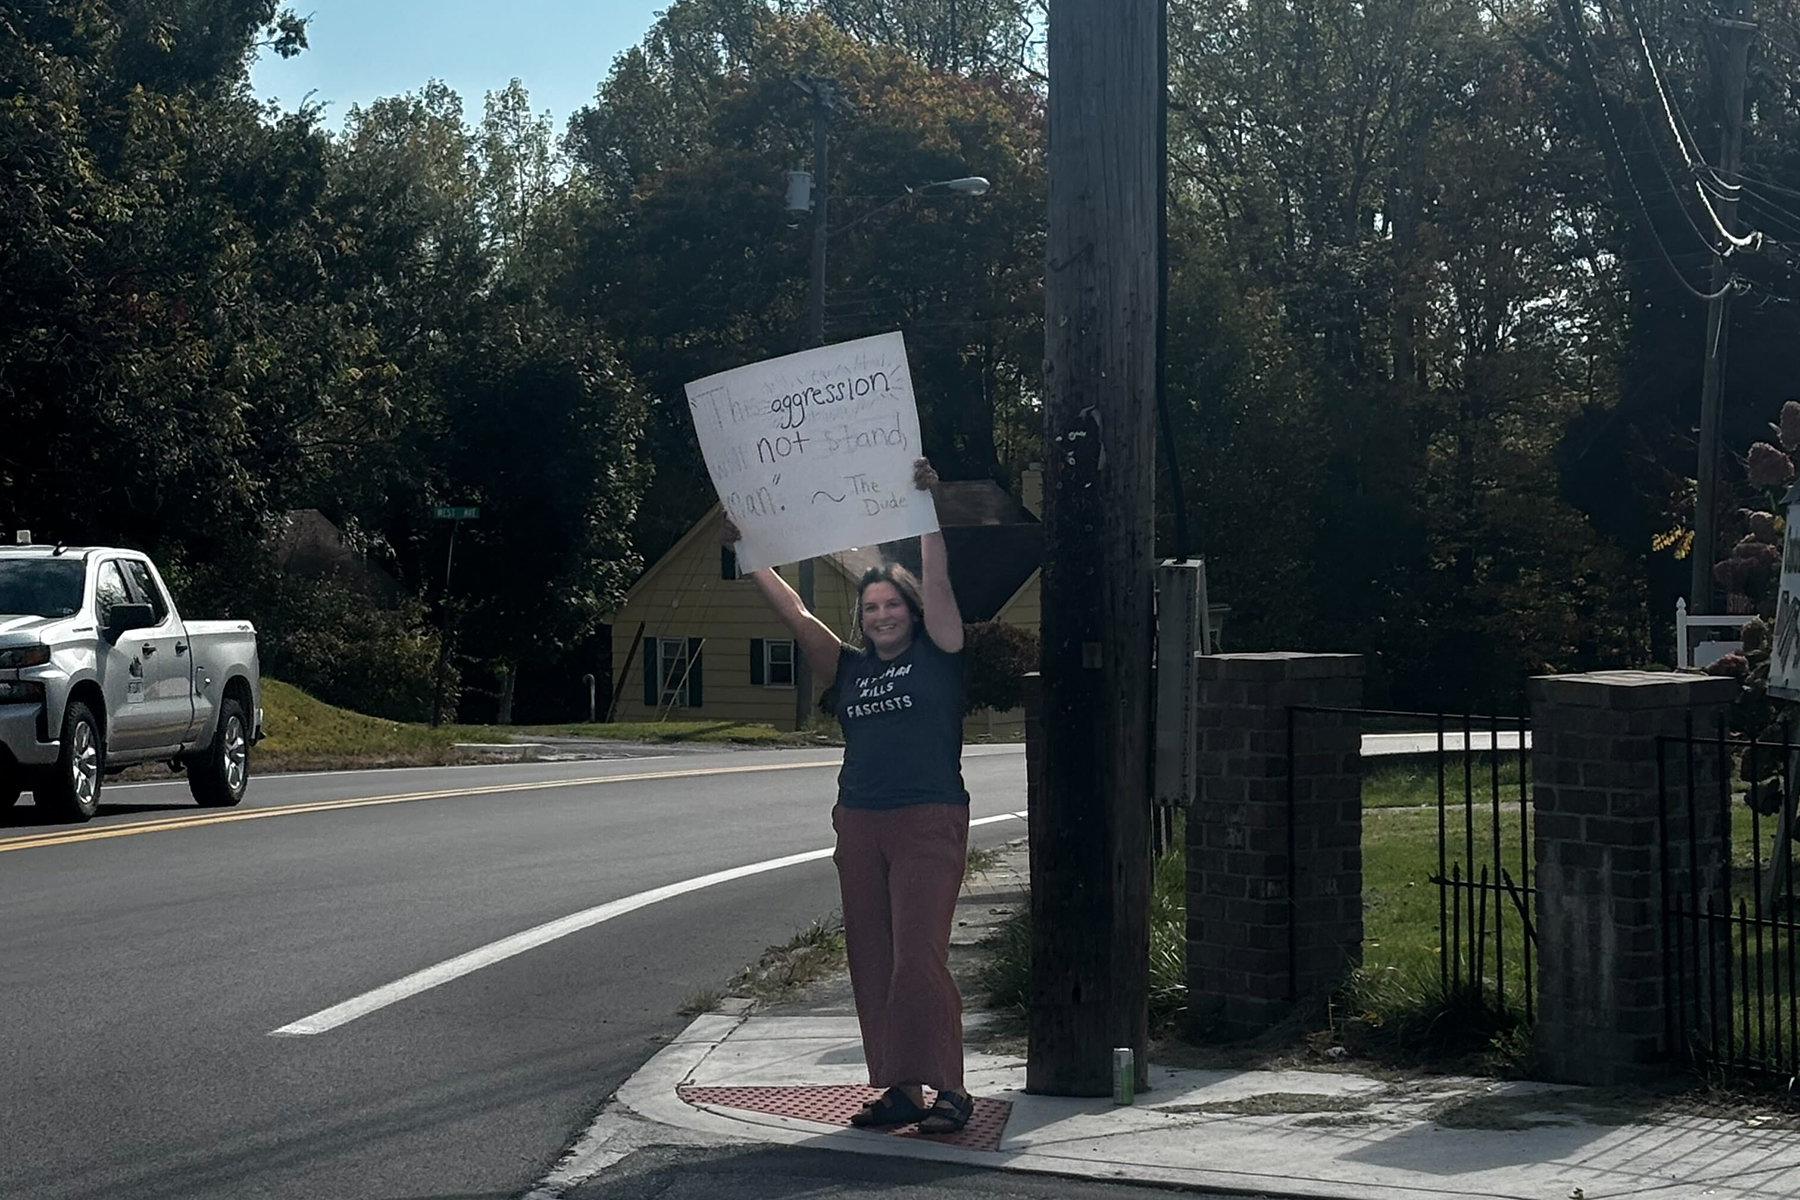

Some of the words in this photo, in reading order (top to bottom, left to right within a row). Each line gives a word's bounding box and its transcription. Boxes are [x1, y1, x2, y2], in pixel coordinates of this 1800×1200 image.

[771, 372, 891, 429] aggression
[757, 431, 810, 464] not
[843, 473, 880, 495] The
[863, 491, 908, 516] Dude
[860, 682, 894, 698] KILLS
[847, 695, 913, 718] FASCISTS
